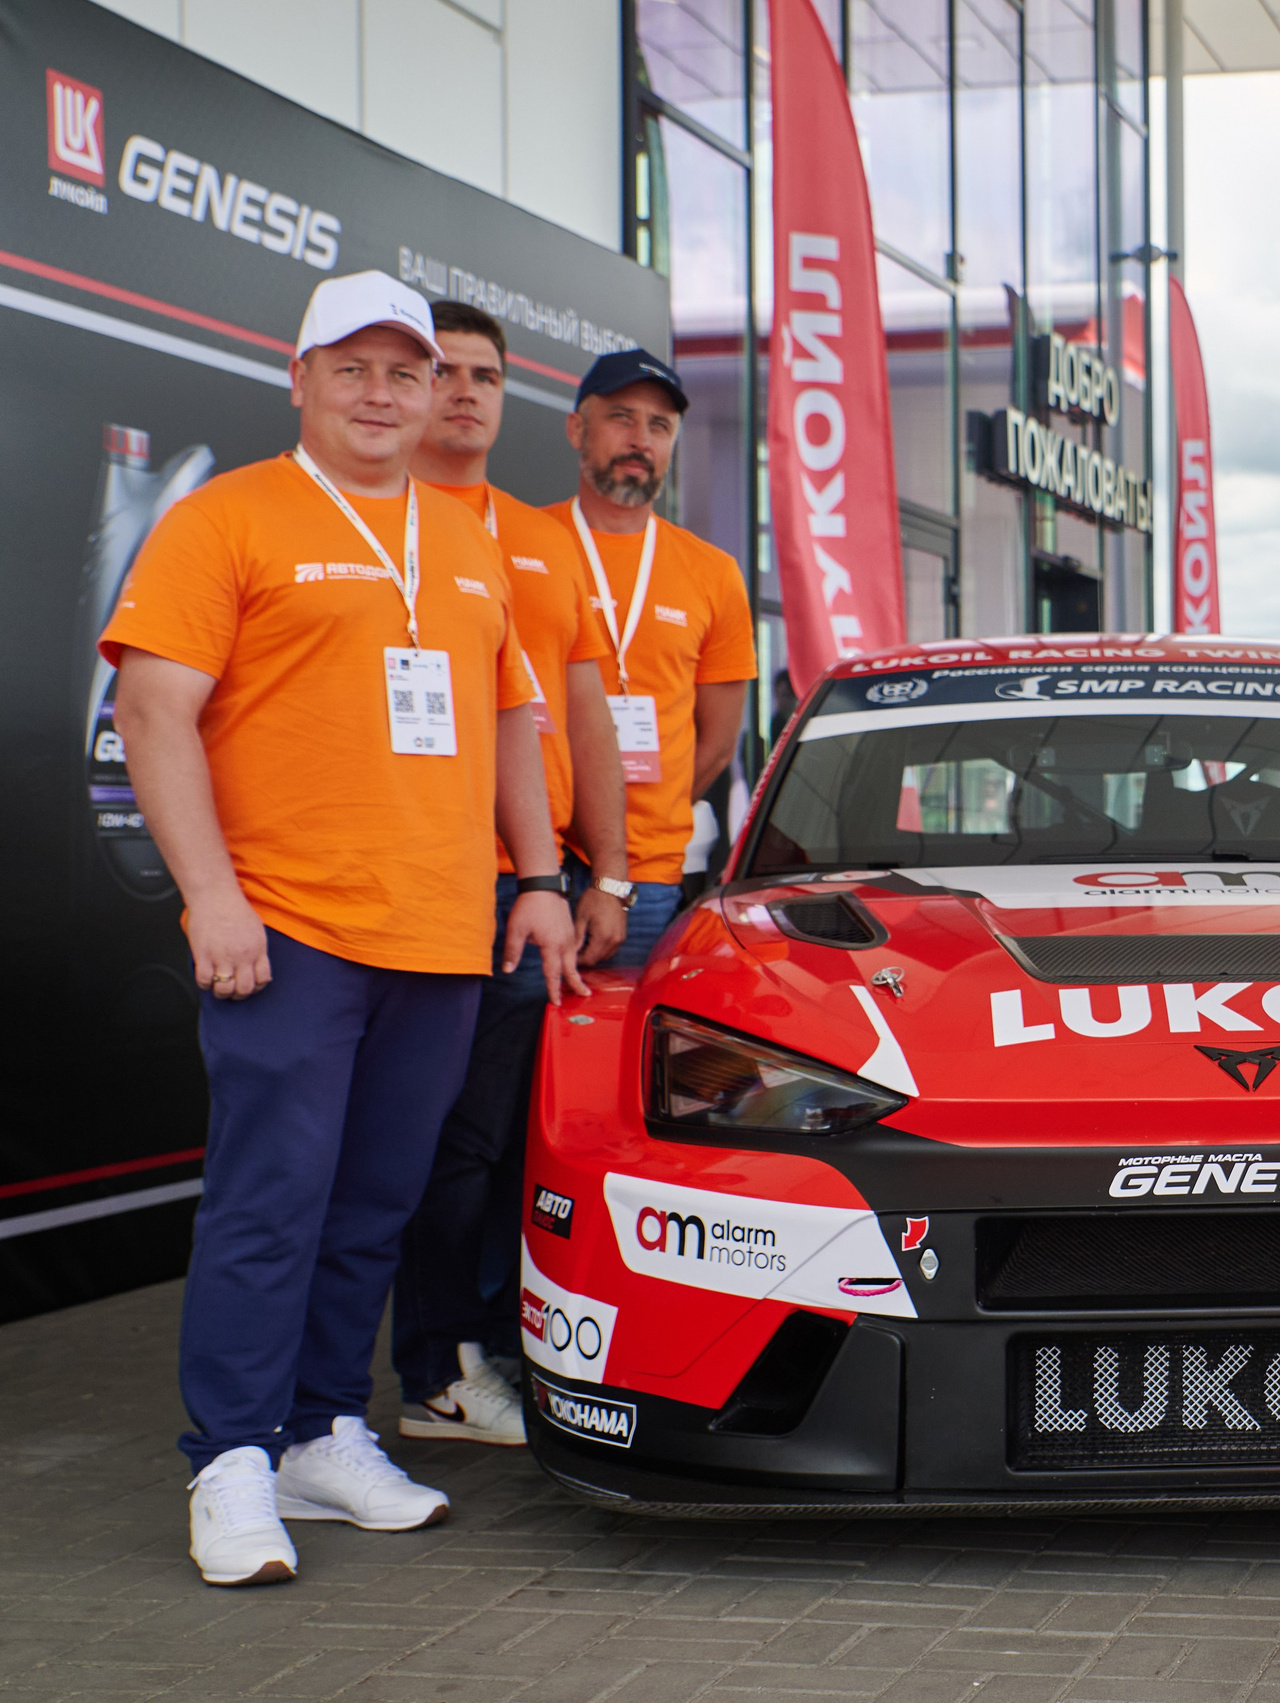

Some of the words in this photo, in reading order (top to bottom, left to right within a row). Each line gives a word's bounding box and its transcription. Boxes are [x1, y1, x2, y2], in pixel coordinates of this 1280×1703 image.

[118, 134, 342, 271] GENESIS
[399, 245, 448, 297] ВАШ
[449, 265, 581, 347] ПРАВИЛЬНЫЙ
[1047, 331, 1120, 427] ДОБРО
[782, 230, 864, 659] ЛУКОЙЛ
[852, 652, 993, 673] LUKOIL
[1007, 647, 1168, 660] RACING
[931, 665, 1074, 680] Российская
[1080, 665, 1152, 674] серия
[1054, 679, 1145, 695] SMP
[1118, 1154, 1204, 1166] МОТОРНЫЕ
[1208, 1153, 1263, 1162] МАСЛА
[535, 1190, 573, 1219] АВТО
[636, 1206, 705, 1260] am
[711, 1219, 776, 1247] alarm
[709, 1247, 787, 1272] motors
[542, 1303, 601, 1360] 100
[547, 1392, 629, 1438] YOKOHAMA
